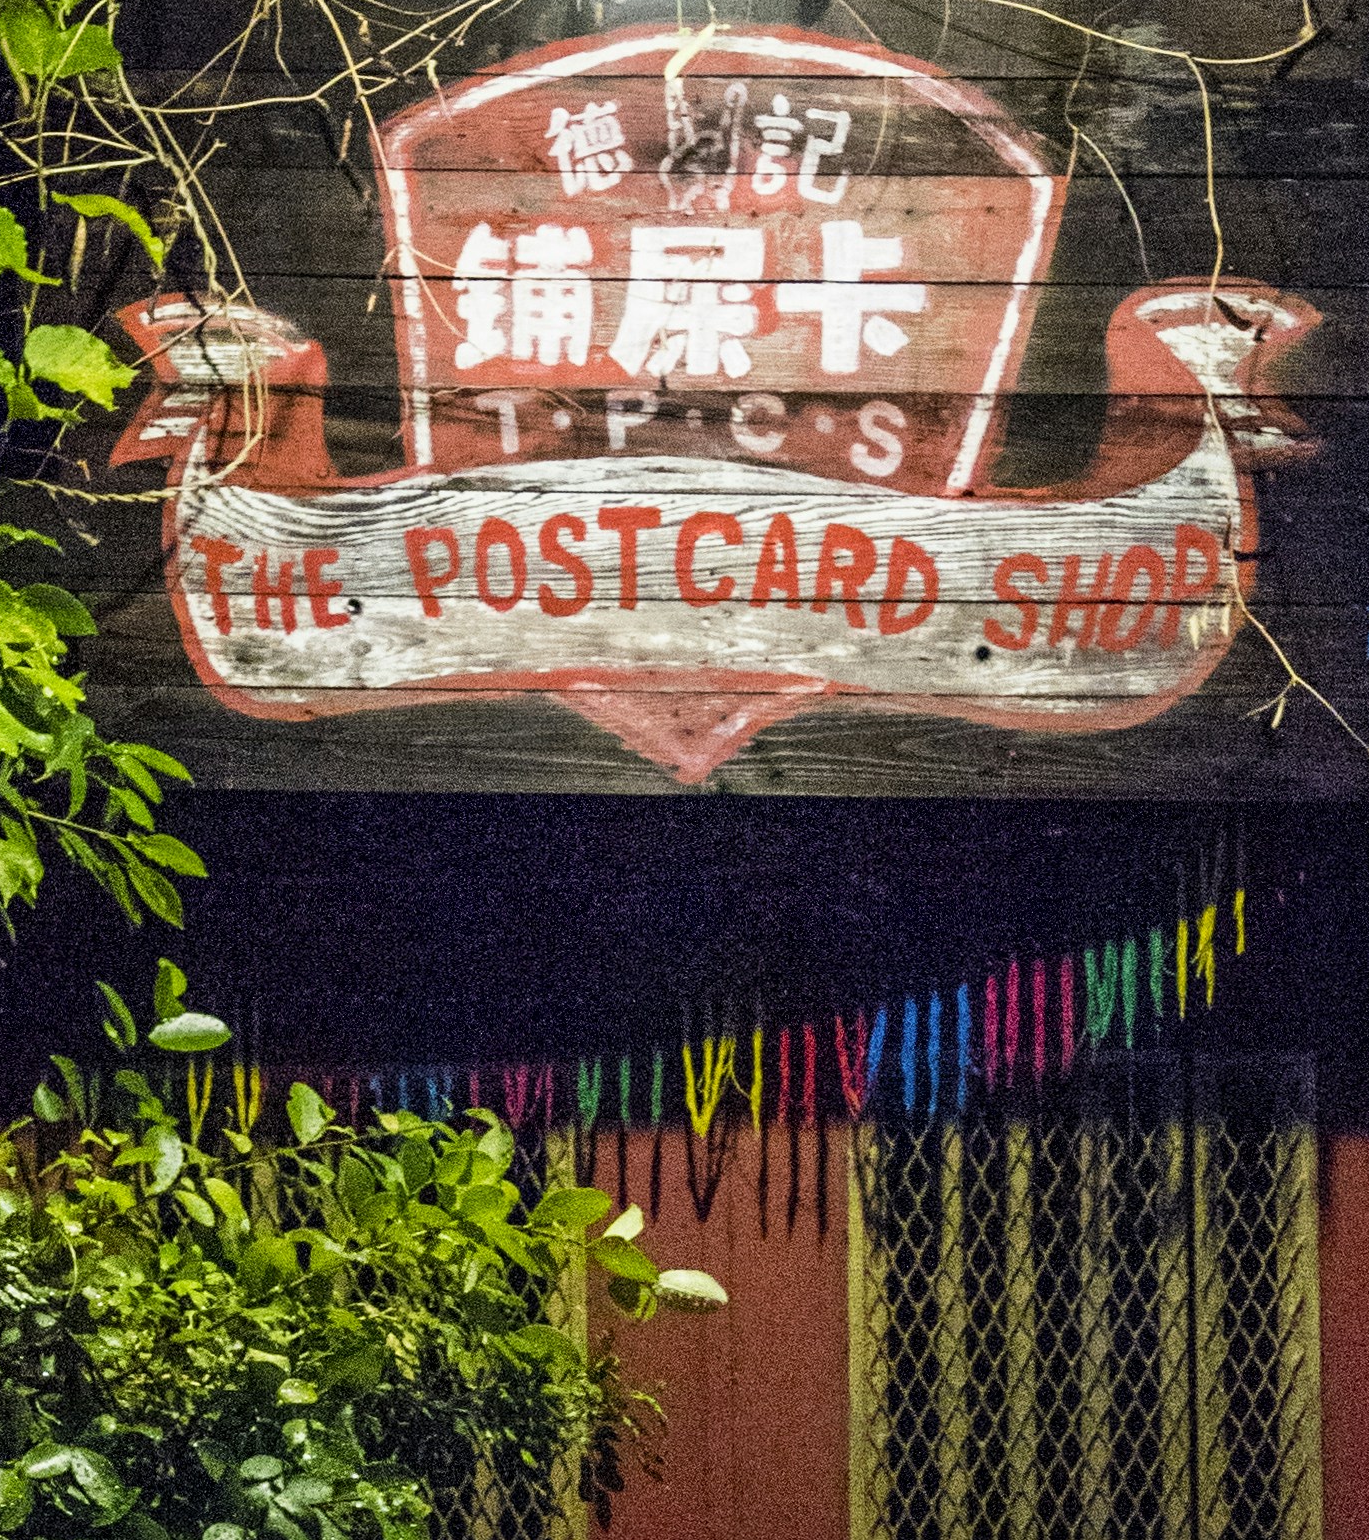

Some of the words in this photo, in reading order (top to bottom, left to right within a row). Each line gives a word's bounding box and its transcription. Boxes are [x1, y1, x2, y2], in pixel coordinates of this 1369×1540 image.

[189, 534, 350, 636] THE
[404, 506, 940, 636] POSTCARD
[985, 524, 1220, 653] SHOP
